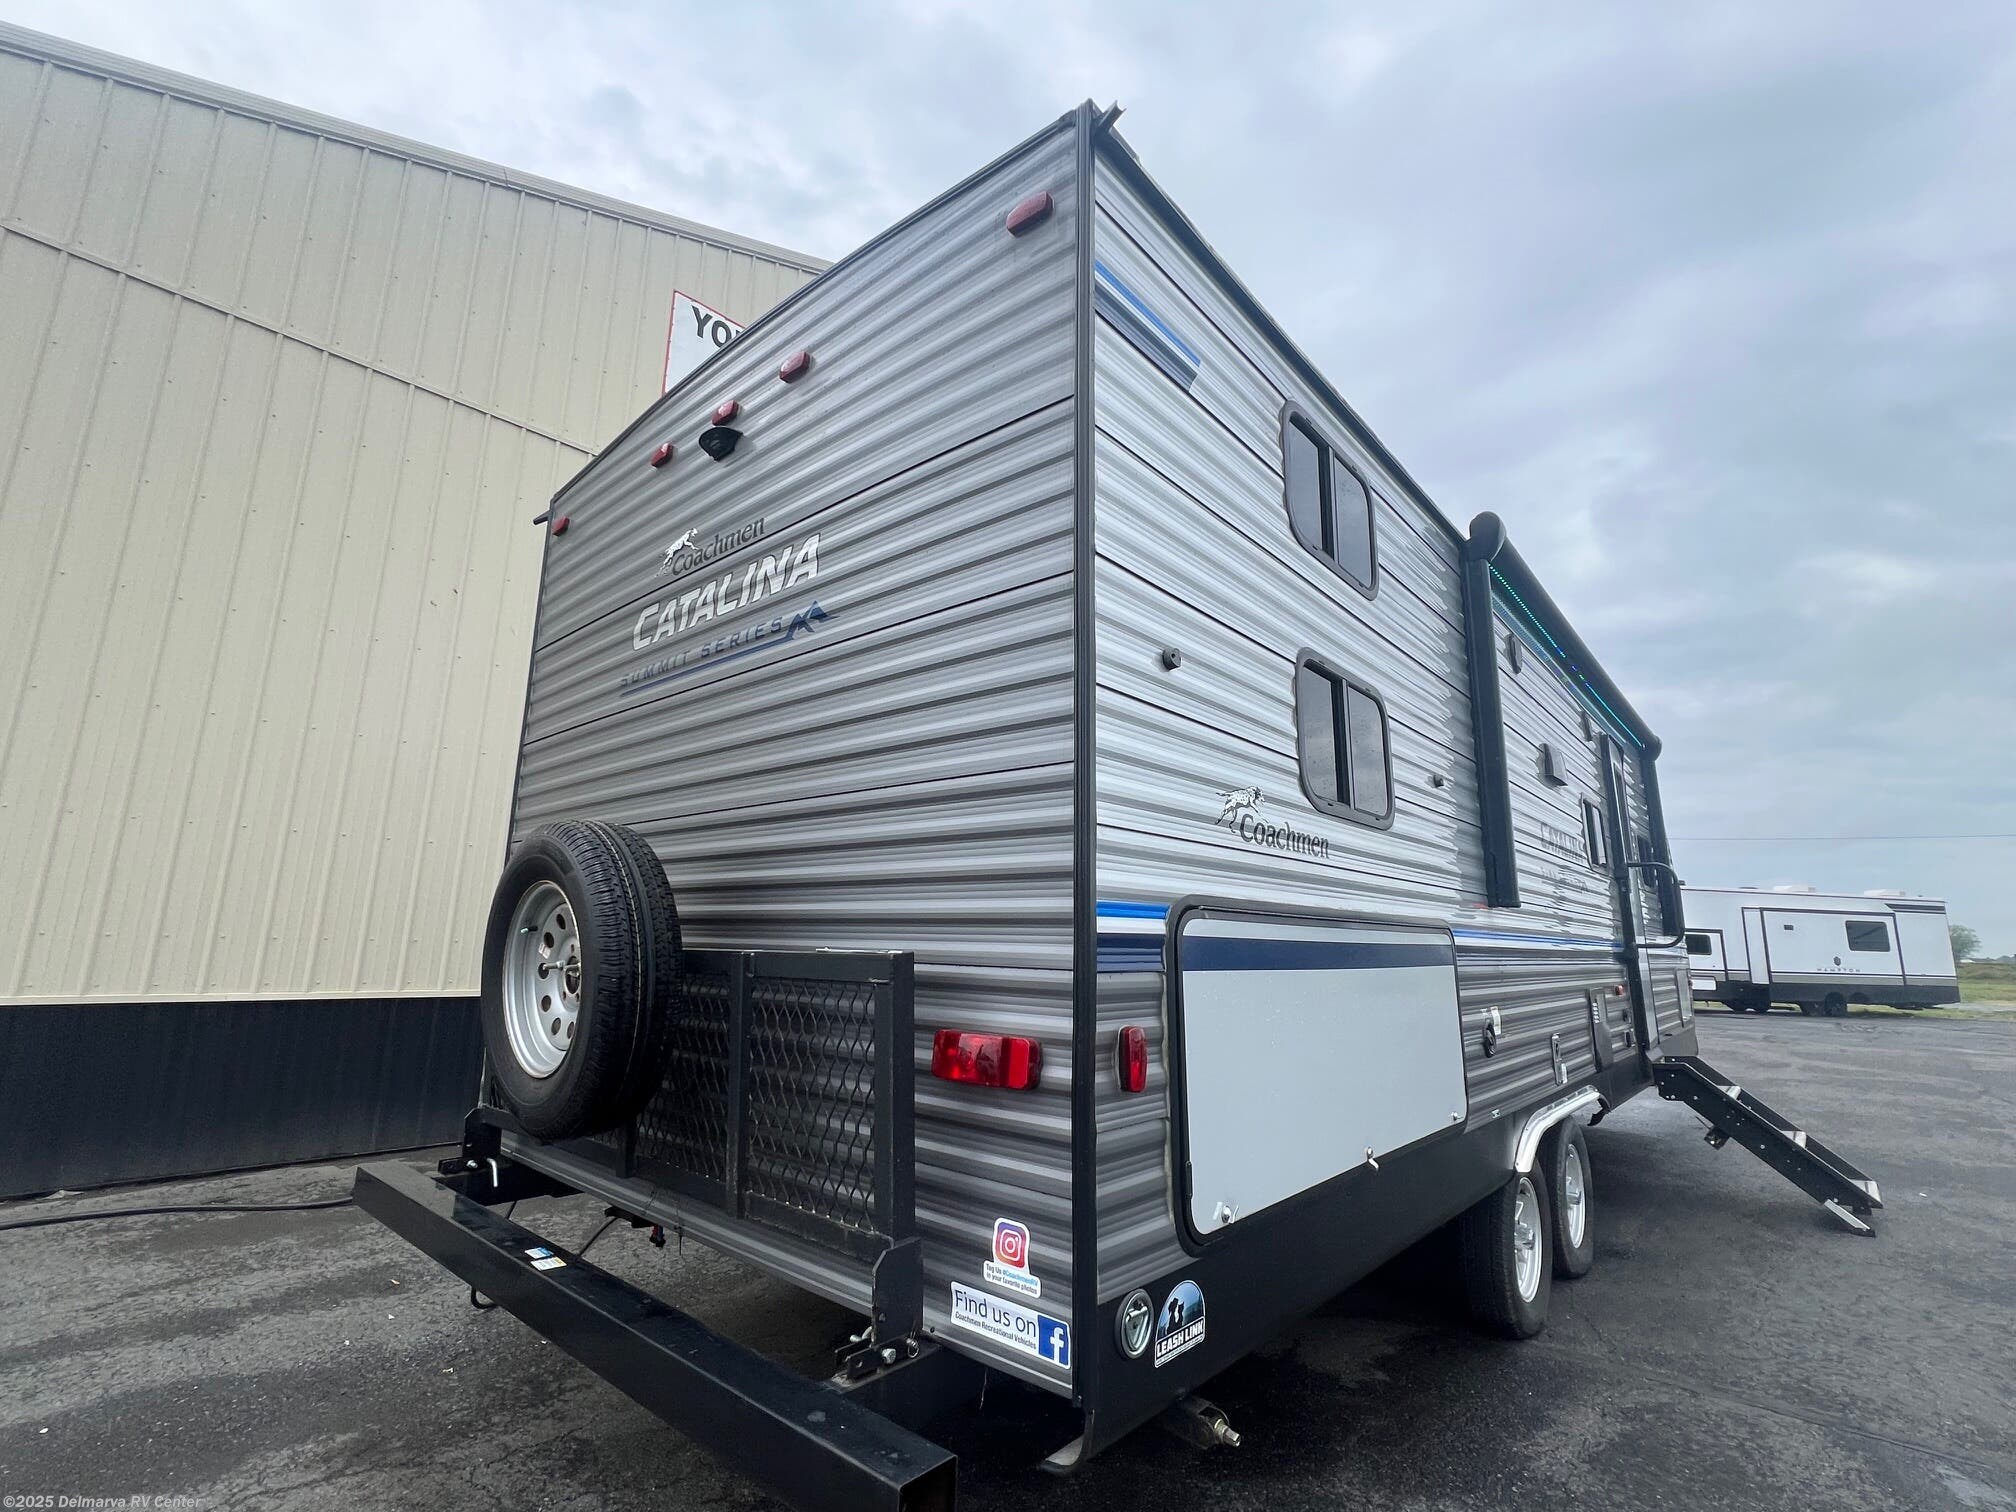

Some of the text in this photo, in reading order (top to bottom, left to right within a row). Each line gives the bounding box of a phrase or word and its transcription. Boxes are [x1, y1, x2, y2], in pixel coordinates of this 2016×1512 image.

[691, 304, 742, 348] YO
[672, 517, 766, 576] Coachmen
[632, 533, 821, 651] CATALINA
[701, 616, 783, 658] SERIES
[1240, 813, 1329, 859] Coachmen
[955, 1289, 988, 1318] Find
[992, 1307, 1011, 1327] us
[1015, 1316, 1036, 1338] on
[955, 1311, 1037, 1350] Coachmen Recreational Vehicles
[1156, 1330, 1184, 1358] LEASH
[1184, 1319, 1204, 1342] LINK
